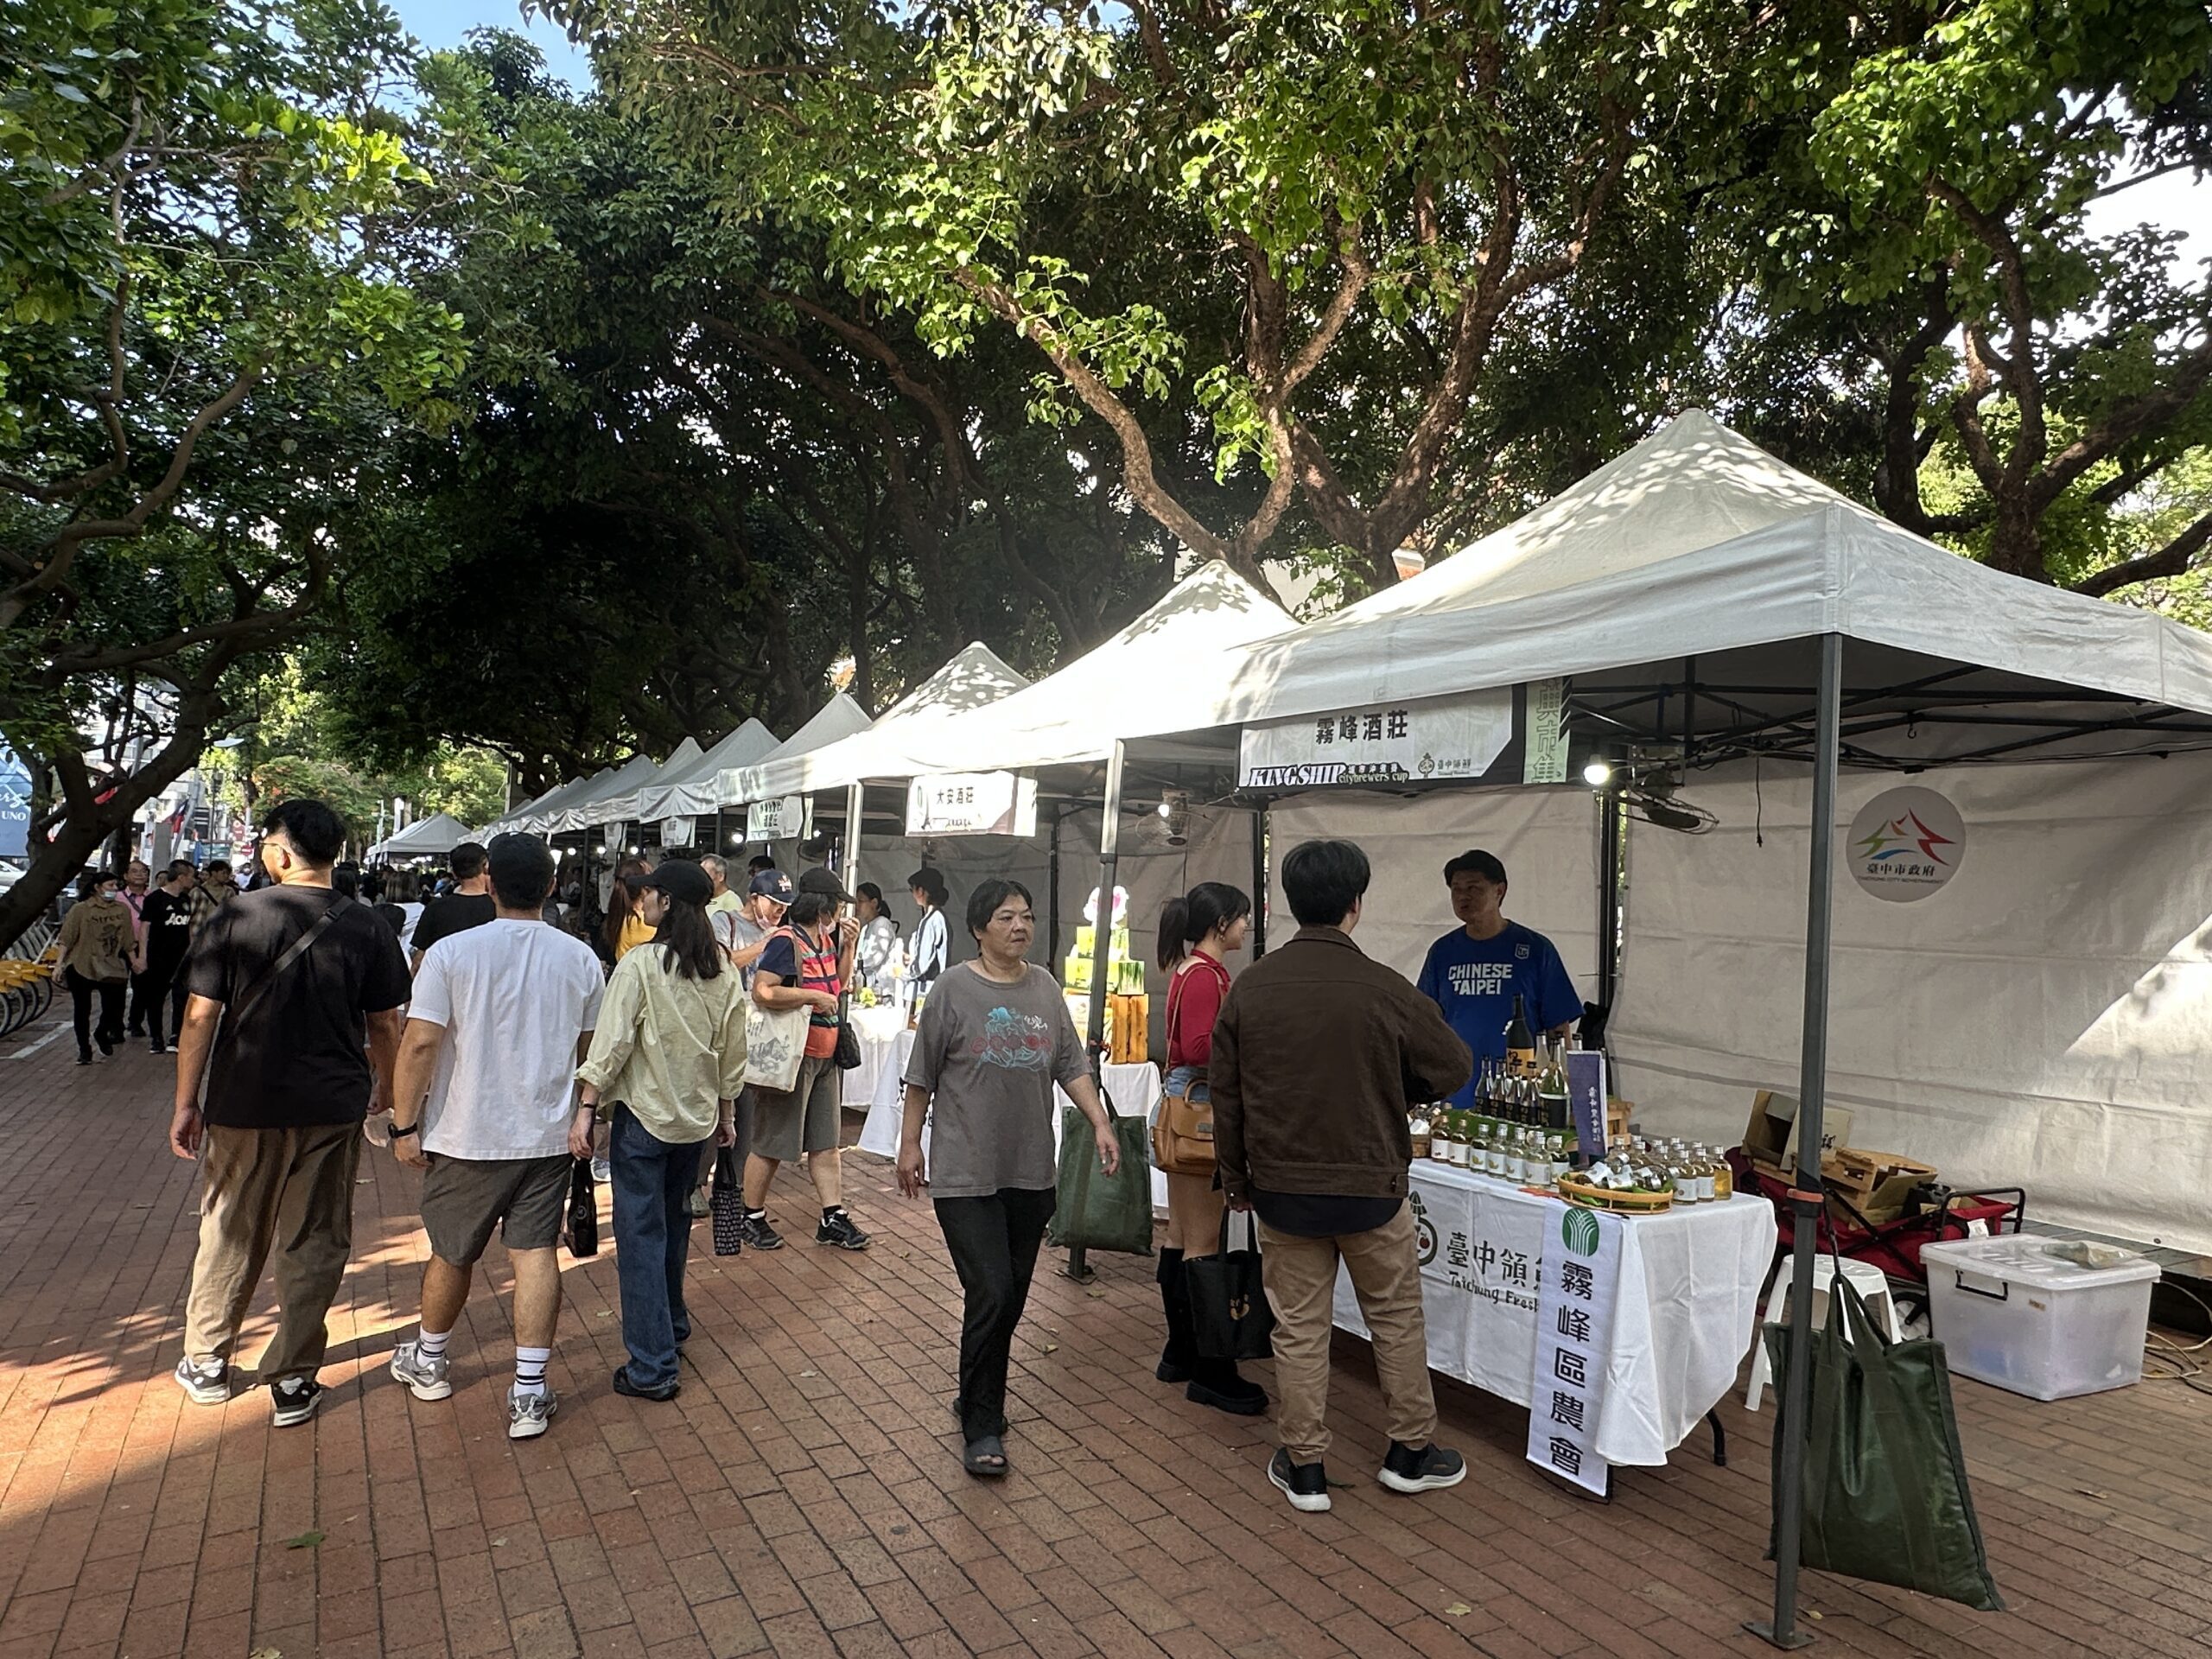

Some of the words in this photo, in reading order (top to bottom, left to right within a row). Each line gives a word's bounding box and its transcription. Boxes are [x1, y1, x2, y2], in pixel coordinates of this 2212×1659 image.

[1316, 709, 1408, 745] 霧峰酒莊
[1249, 764, 1345, 787] KINGSHIP
[2, 811, 27, 822] UNO
[1448, 963, 1513, 981] CHINESE
[1452, 979, 1502, 995] TAIPEI
[1449, 1270, 1499, 1305] Taichung
[1549, 1260, 1594, 1477] 霧峰區農會
